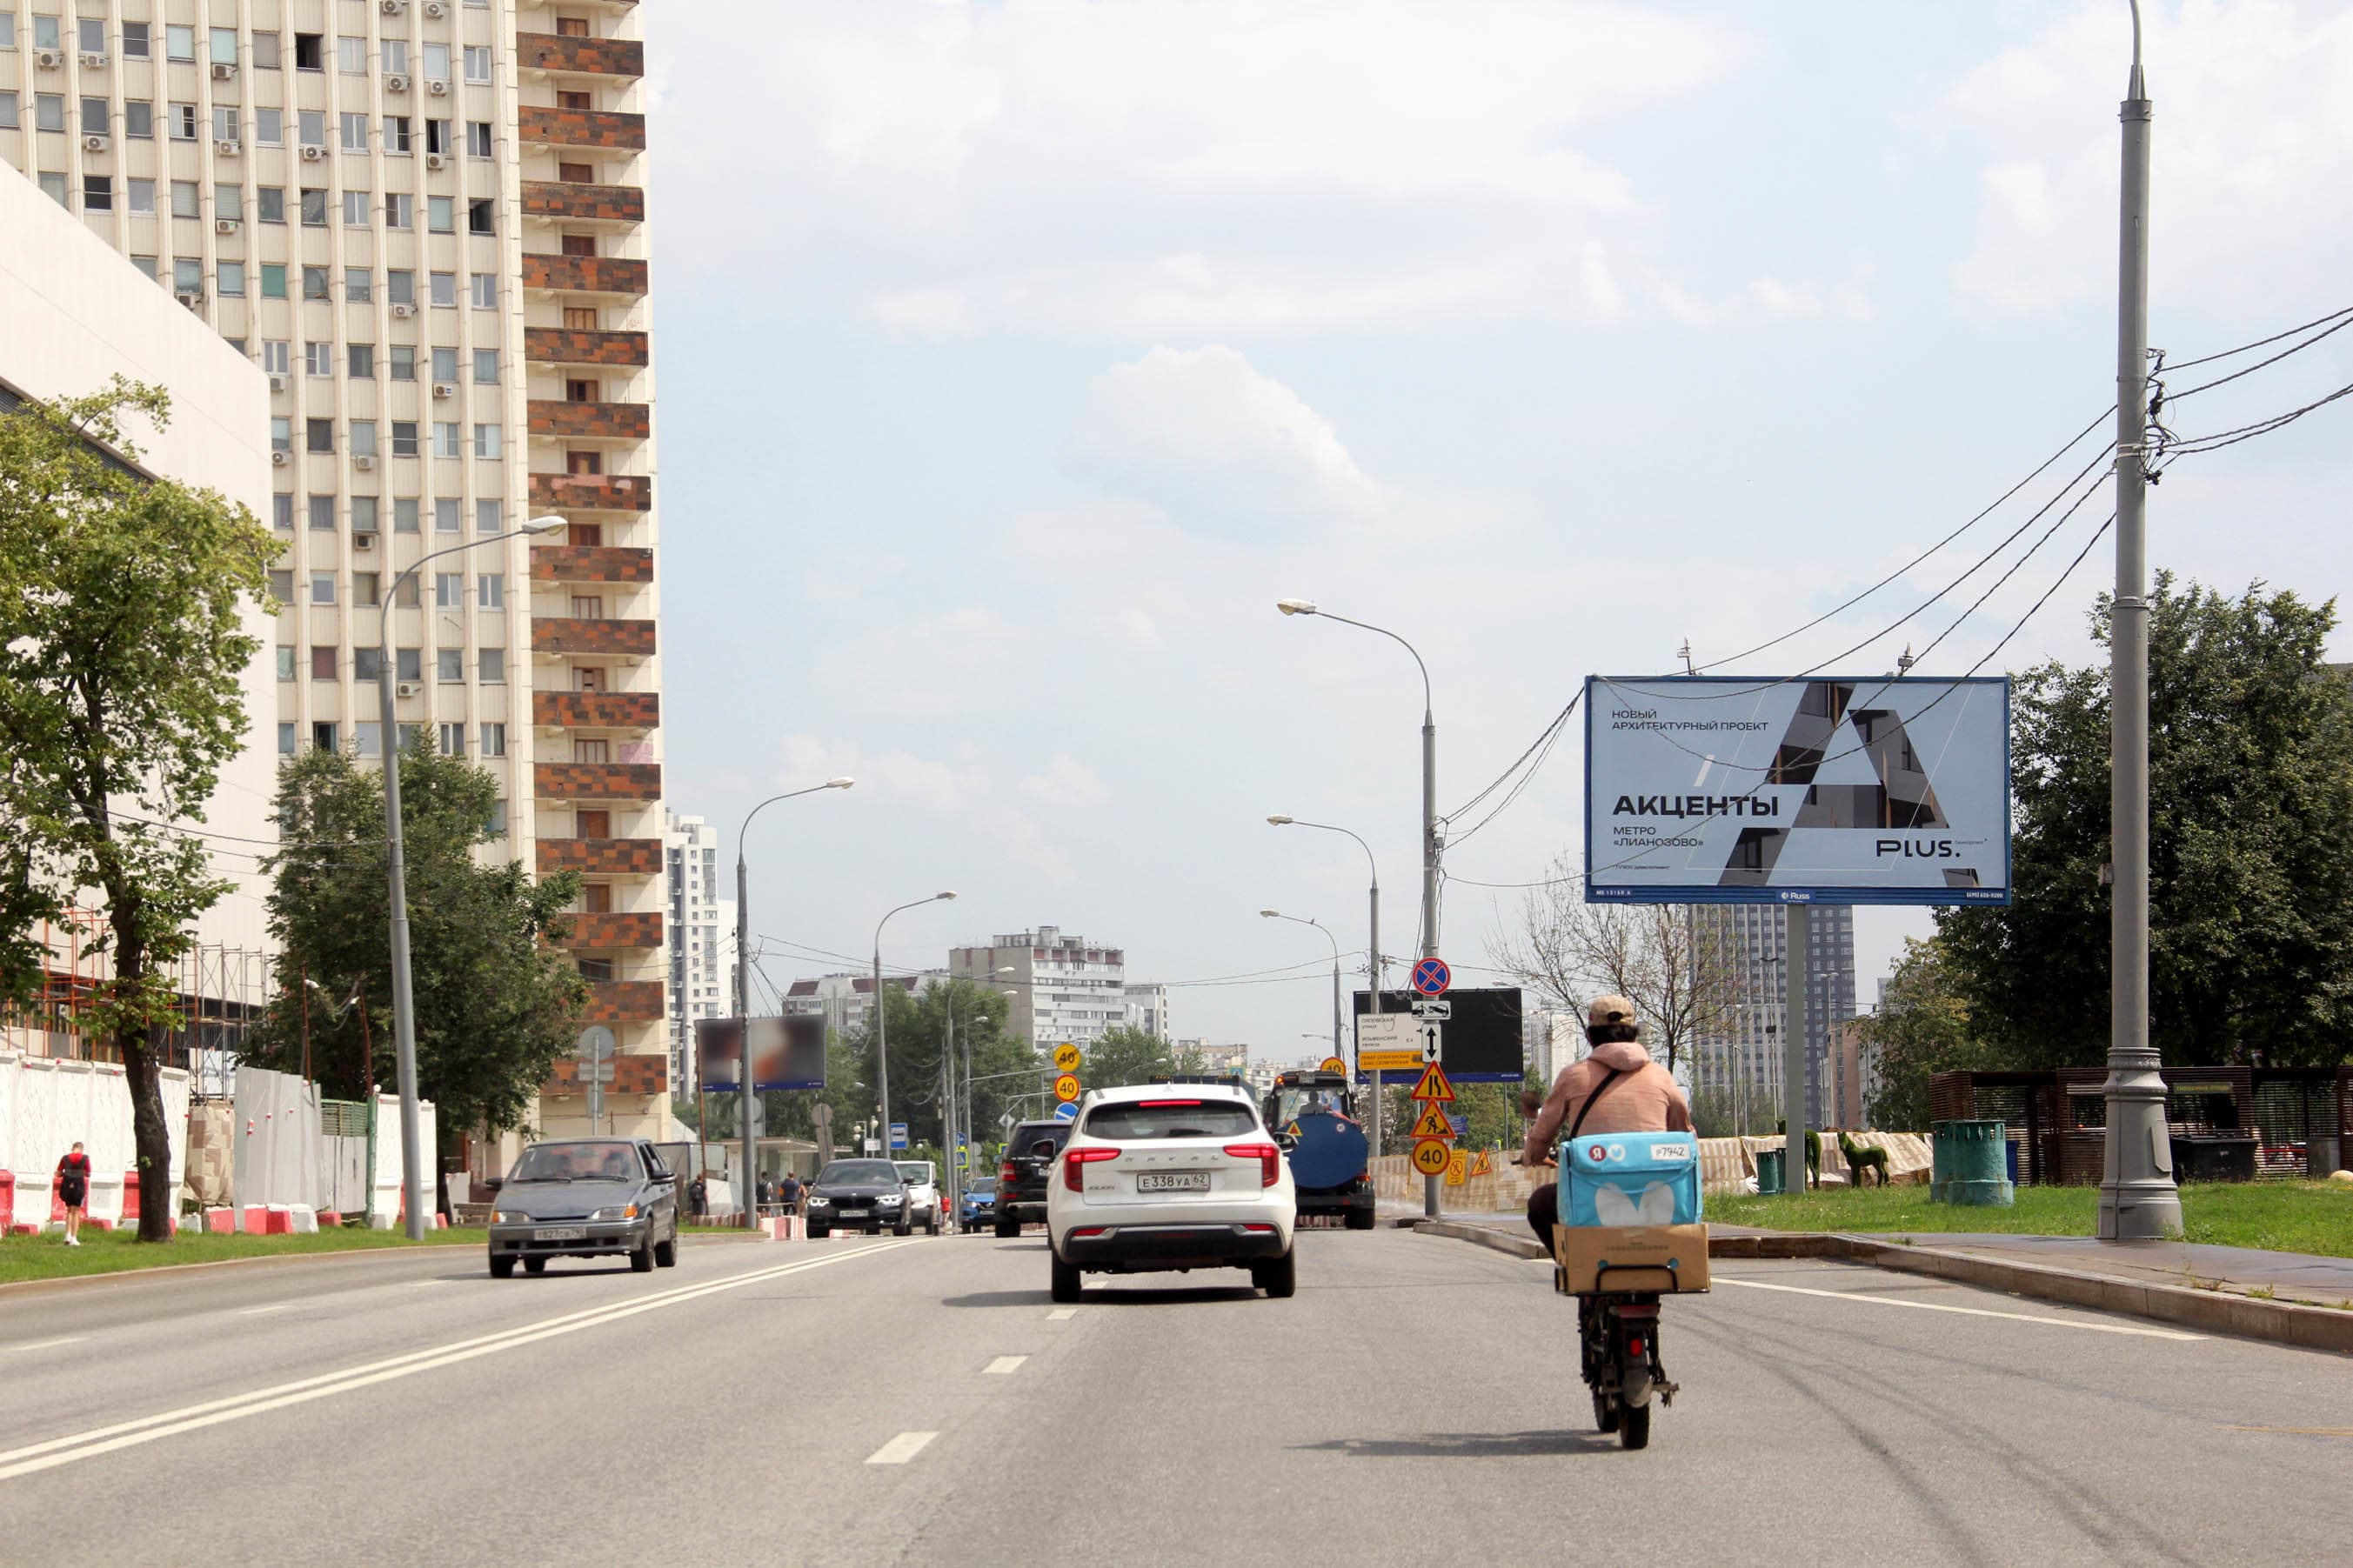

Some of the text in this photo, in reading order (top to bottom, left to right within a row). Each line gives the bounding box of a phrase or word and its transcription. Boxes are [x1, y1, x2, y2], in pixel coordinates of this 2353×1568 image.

[1612, 709, 1657, 719] НОВЫЙ
[1612, 720, 1768, 731] АРХИТЕКТУРНЫЙ ПРОЕКТ
[1612, 795, 1779, 818] АКЦЕНТЫ
[1613, 826, 1656, 836] МЕТРО
[1613, 837, 1704, 847] «ЛИАНОЗОВО»
[1059, 1051, 1075, 1064] 40
[1060, 1082, 1075, 1093] 40
[1420, 1149, 1442, 1164] 40
[1593, 1147, 1602, 1159] Я
